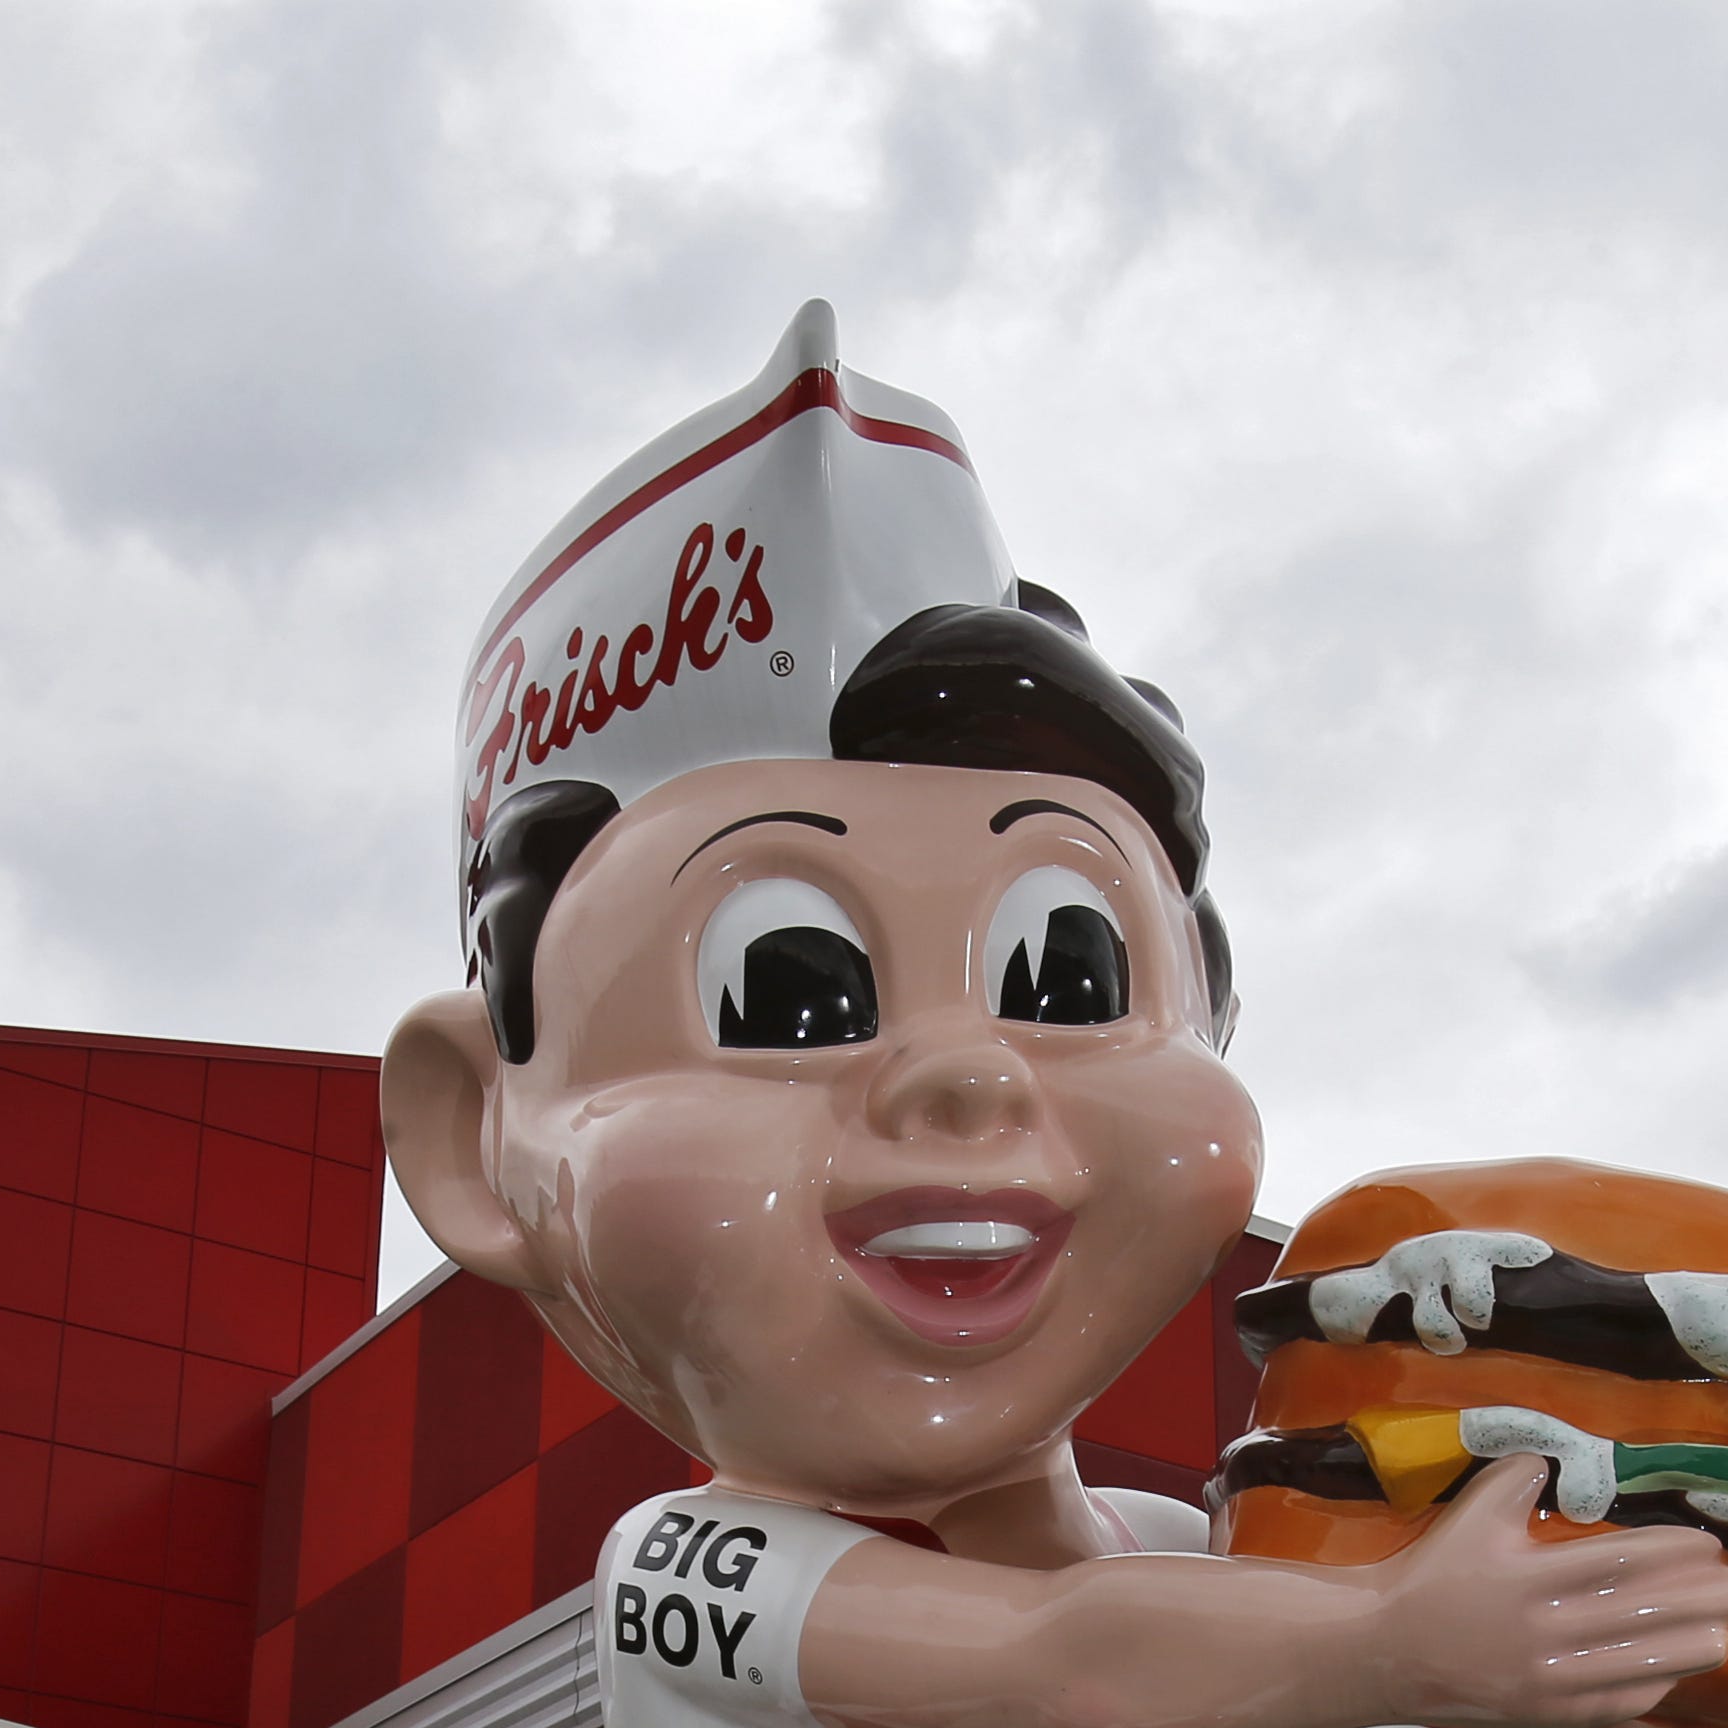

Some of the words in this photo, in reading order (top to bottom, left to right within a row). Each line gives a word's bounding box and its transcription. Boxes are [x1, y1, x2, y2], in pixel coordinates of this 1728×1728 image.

[465, 521, 774, 842] Frisch's
[632, 1511, 768, 1592] BIG
[614, 1582, 758, 1681] BOY
